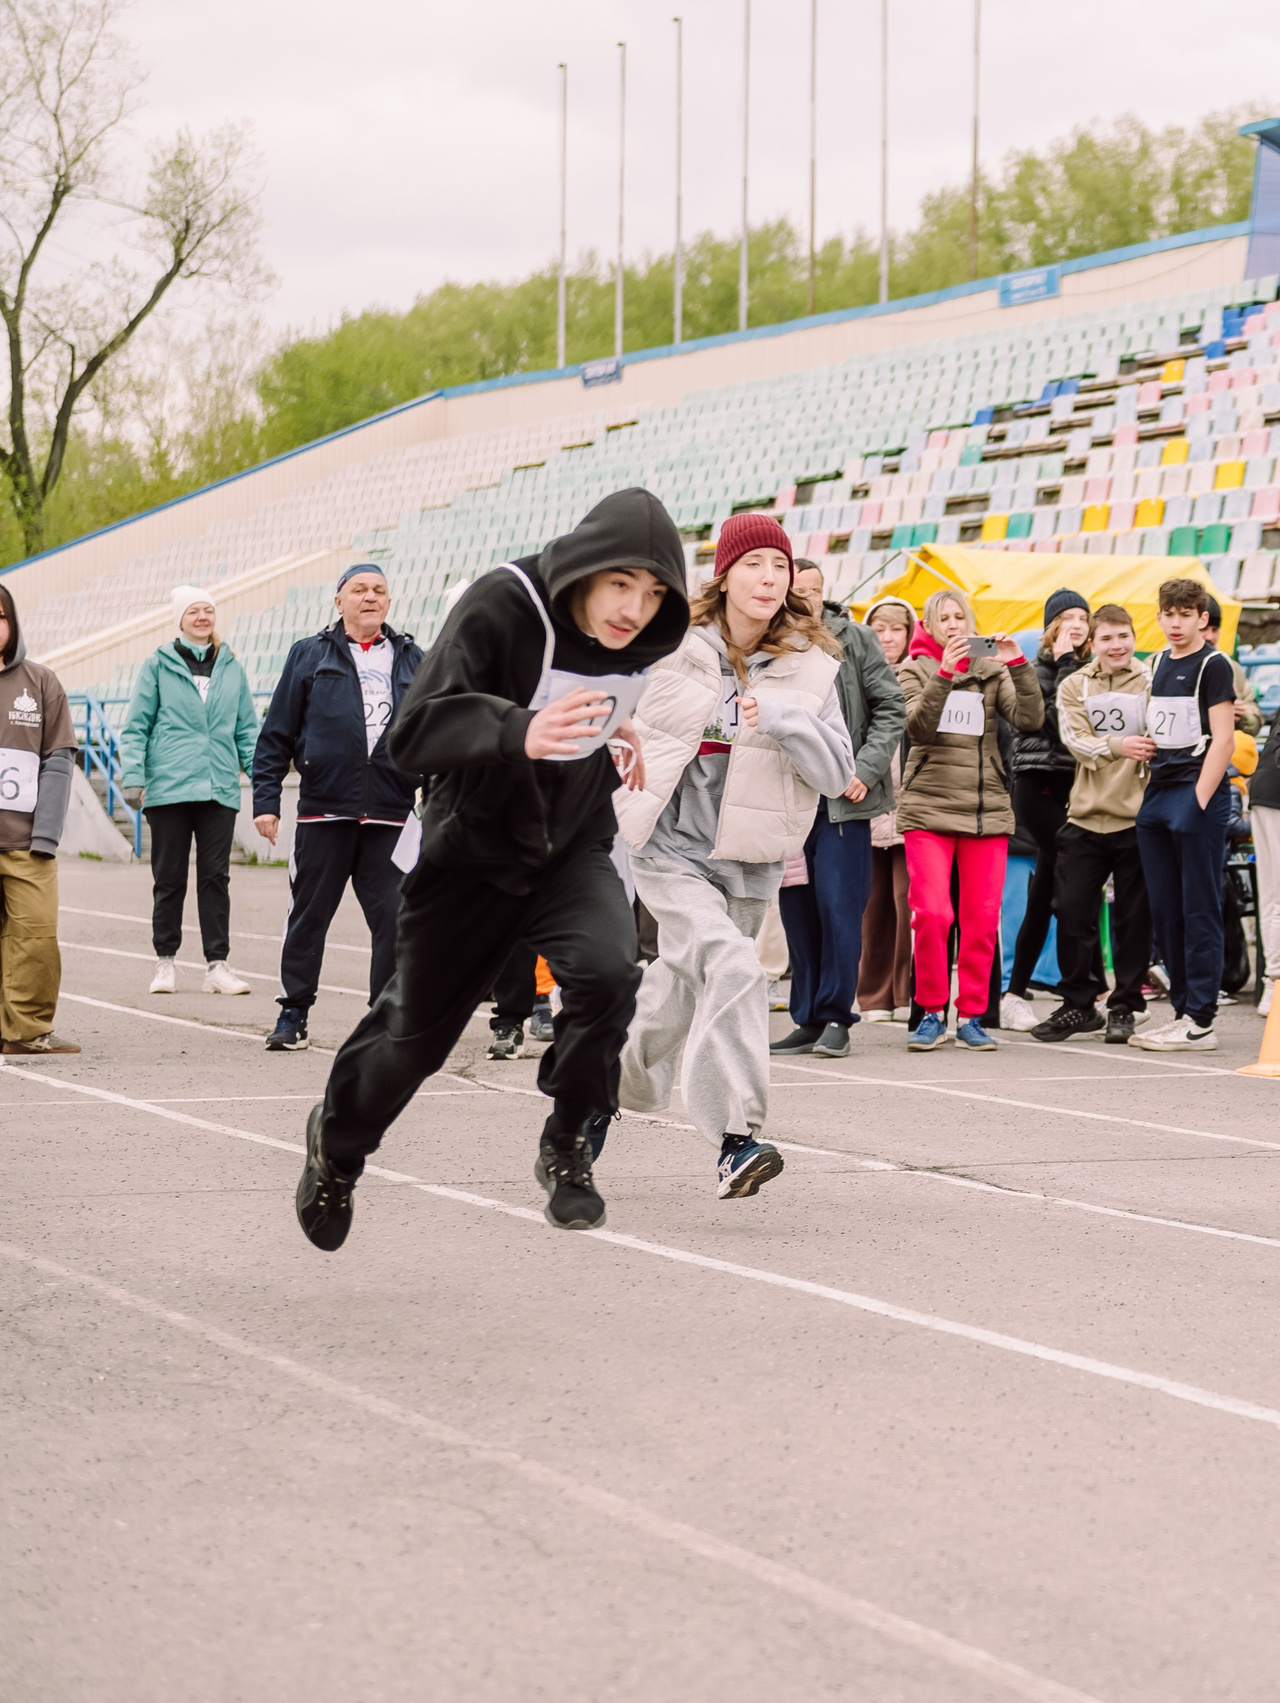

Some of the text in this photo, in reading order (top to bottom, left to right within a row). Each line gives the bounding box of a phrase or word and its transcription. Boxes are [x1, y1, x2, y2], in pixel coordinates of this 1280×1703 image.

[947, 709, 971, 725] 101
[1091, 708, 1126, 732] 23
[1154, 711, 1177, 736] 27
[0, 766, 20, 801] 6
